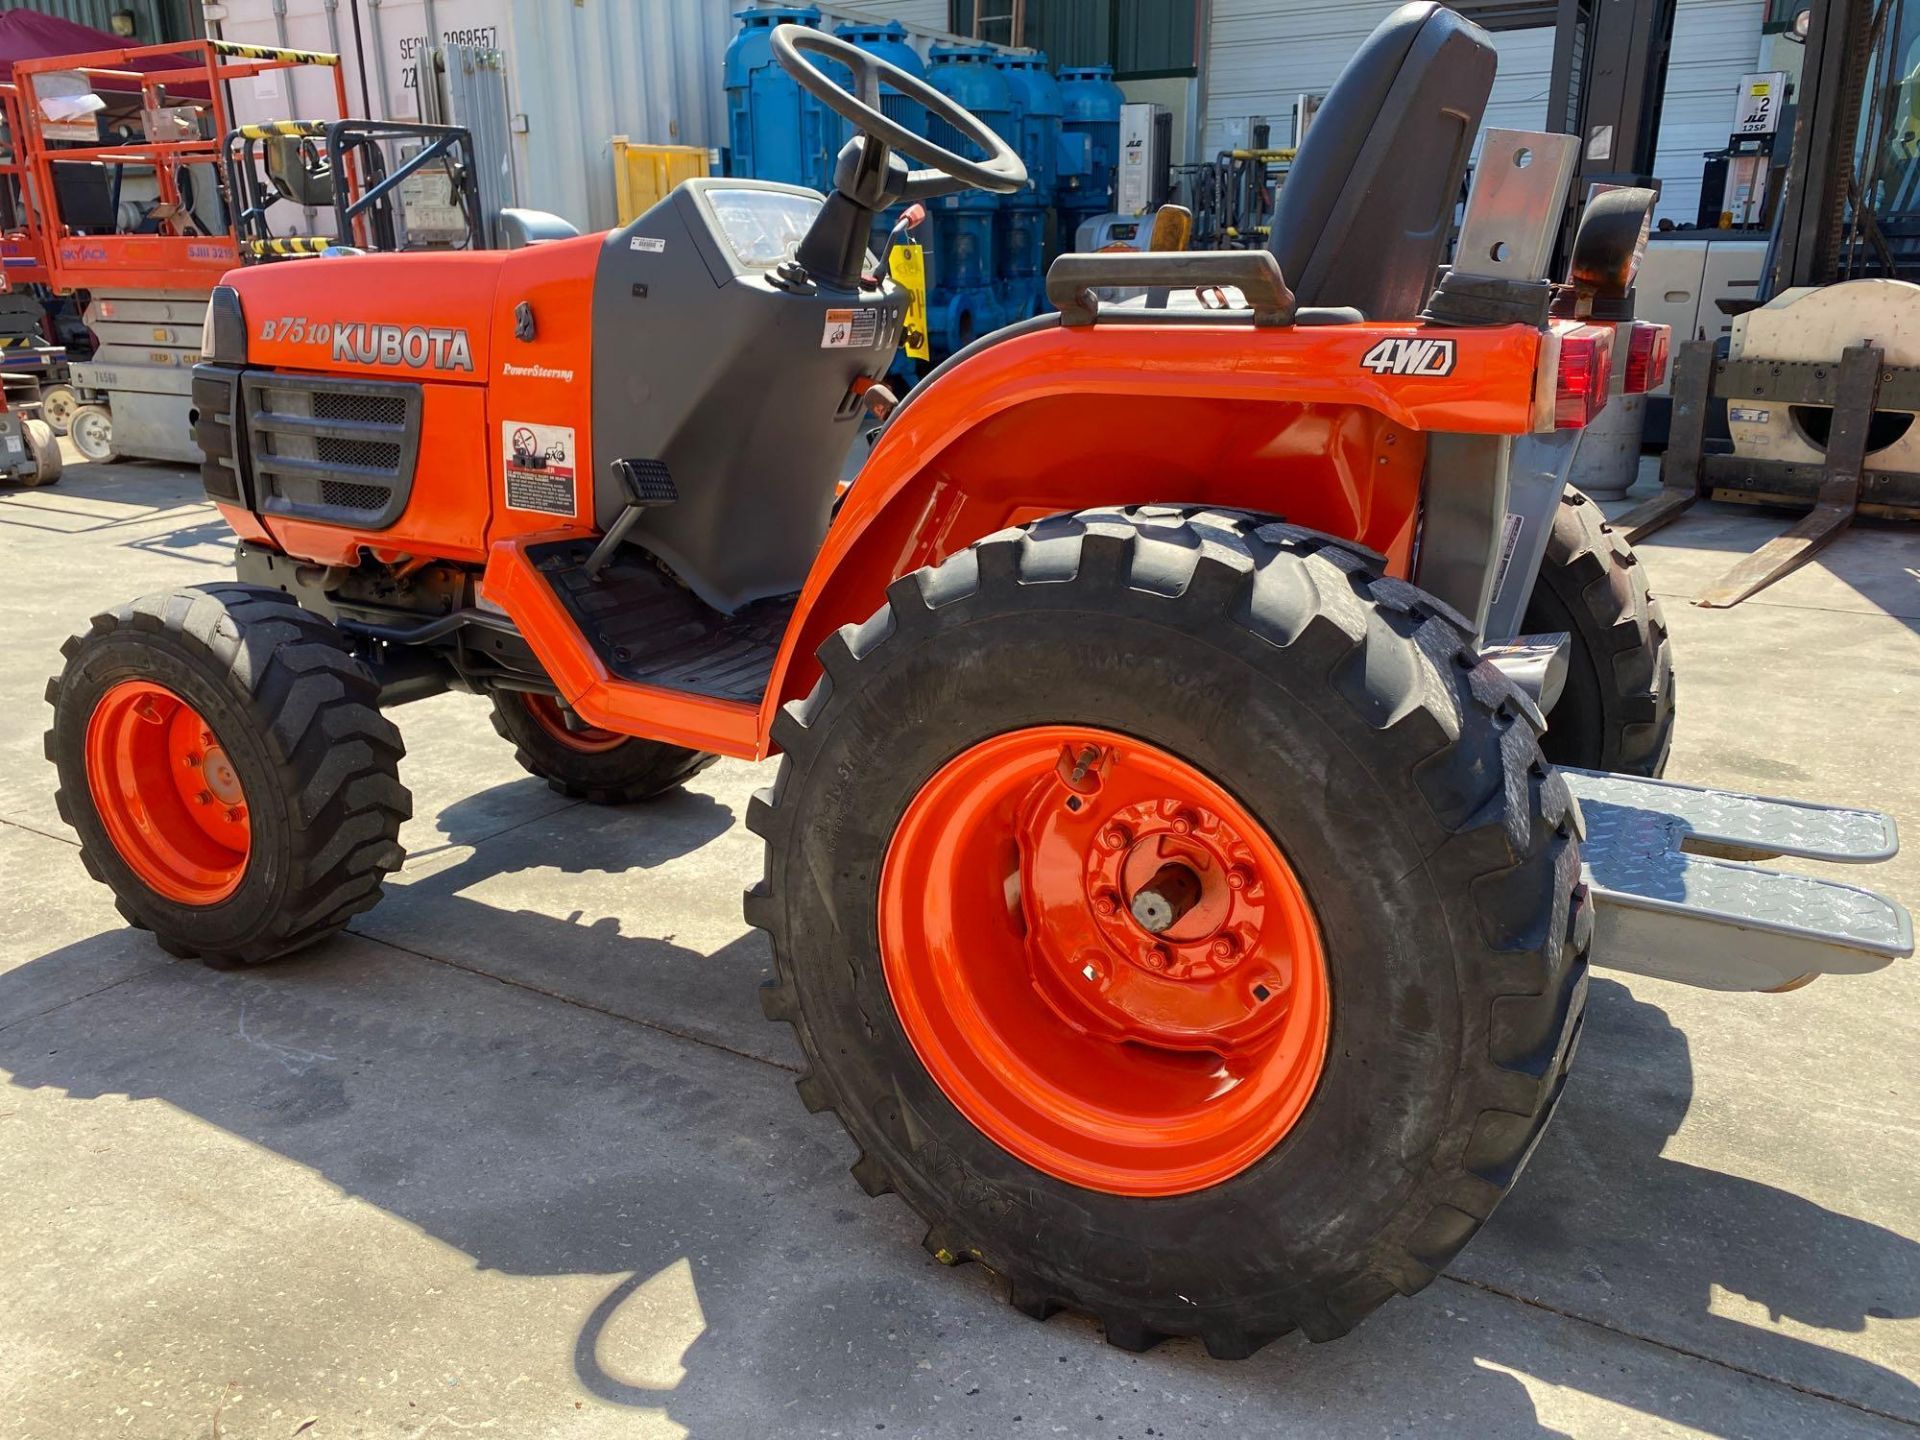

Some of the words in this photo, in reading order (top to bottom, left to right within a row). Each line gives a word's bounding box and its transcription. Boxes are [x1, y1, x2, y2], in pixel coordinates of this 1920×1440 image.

[1743, 124, 1766, 132] 12SP
[1744, 114, 1767, 123] JLG
[260, 317, 330, 345] B7510
[332, 322, 474, 371] KUBOTA
[1361, 337, 1456, 377] 4WD
[502, 362, 573, 383] PowerSteering
